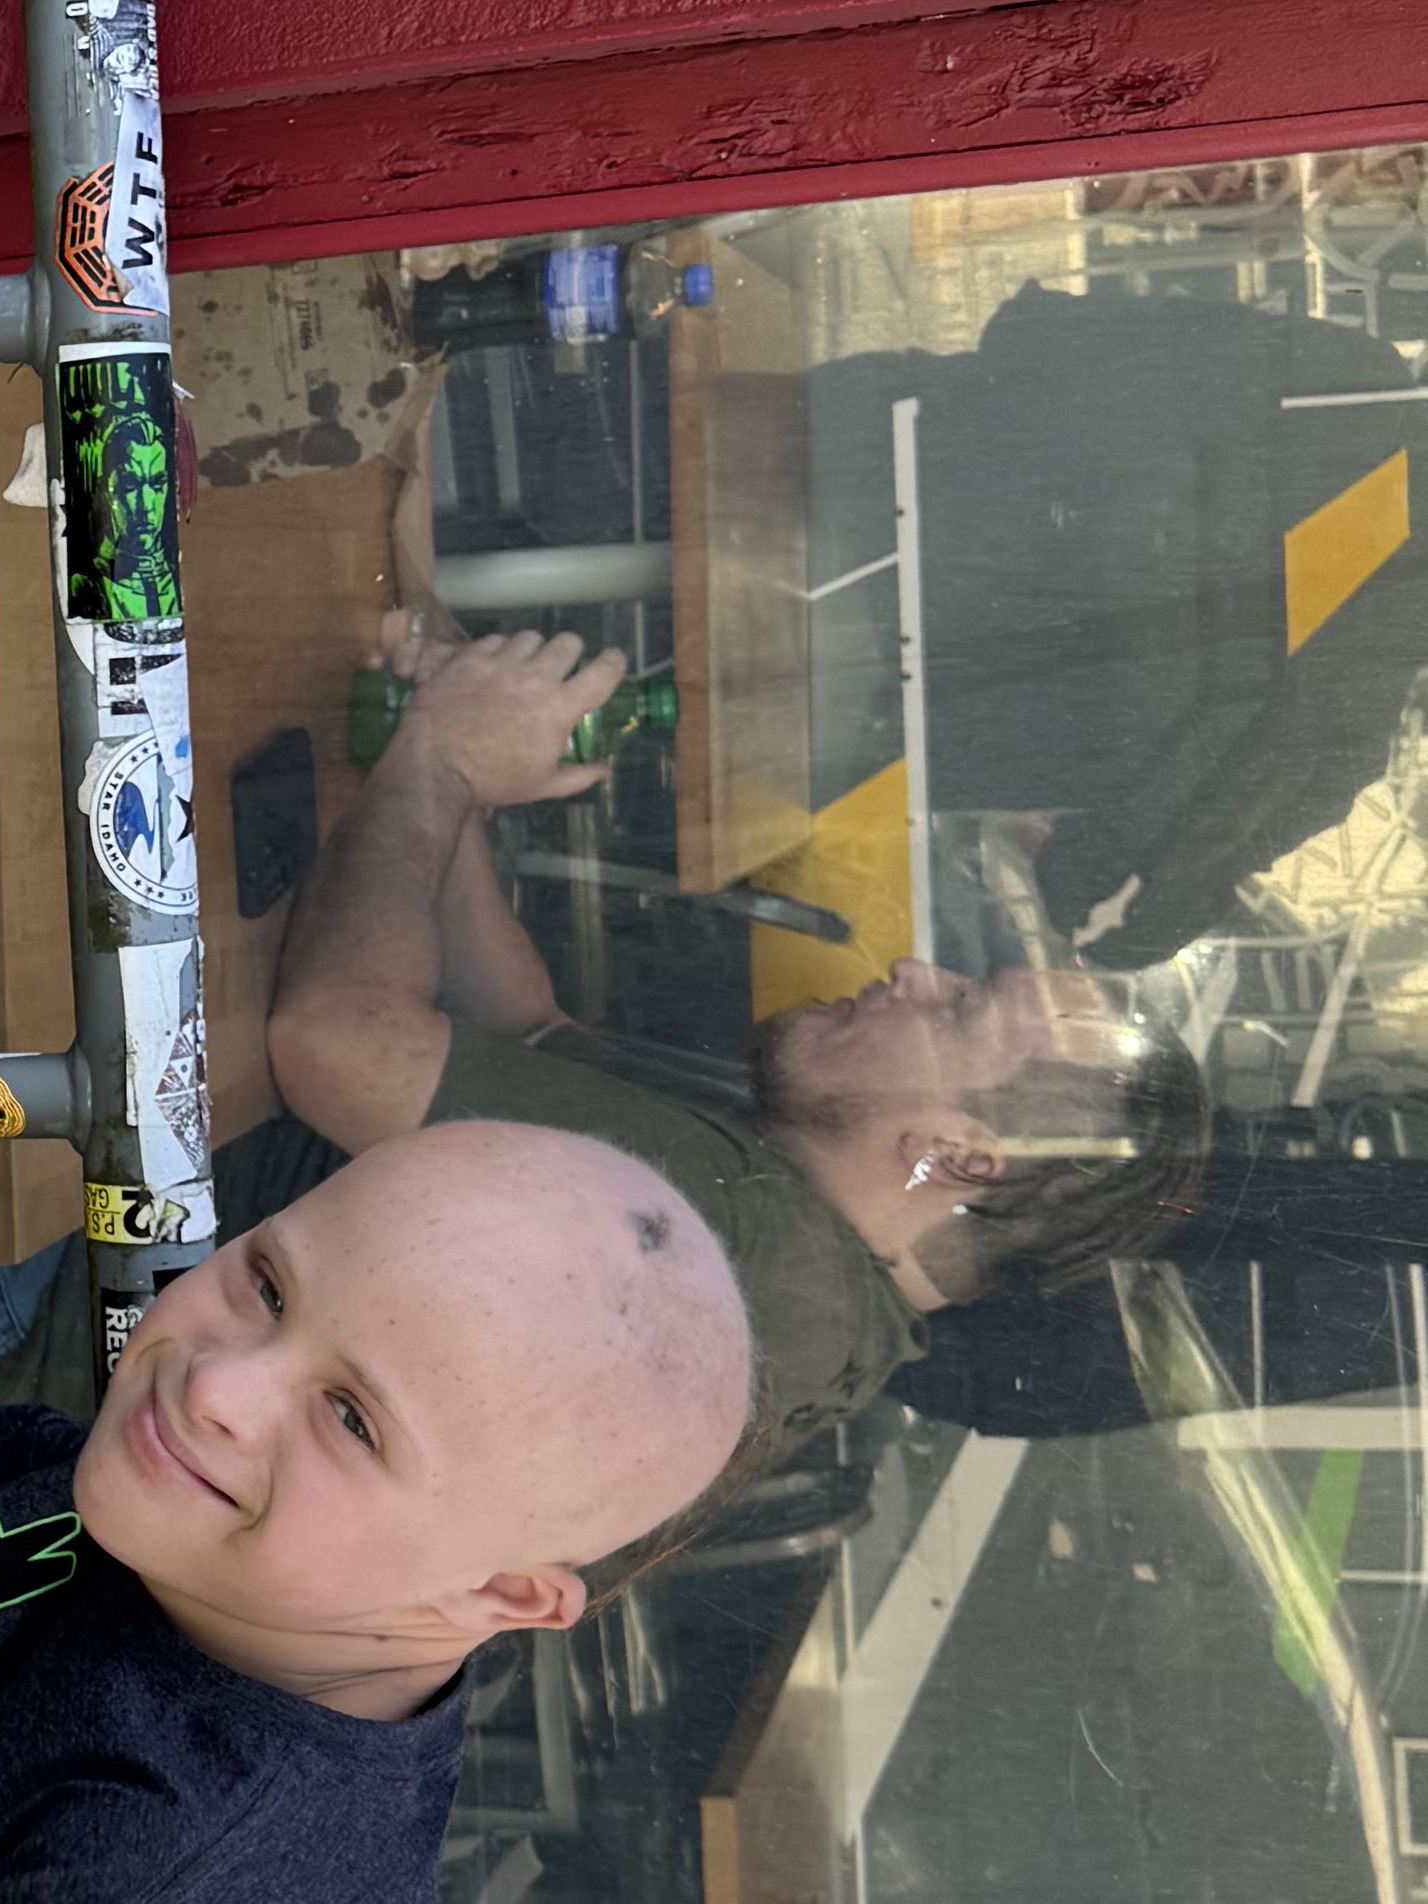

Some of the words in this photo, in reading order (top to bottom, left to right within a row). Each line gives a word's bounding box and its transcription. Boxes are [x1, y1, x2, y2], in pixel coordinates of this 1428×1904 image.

[121, 132, 158, 271] WTF
[101, 771, 125, 811] STAR
[100, 824, 127, 874] IDAHO
